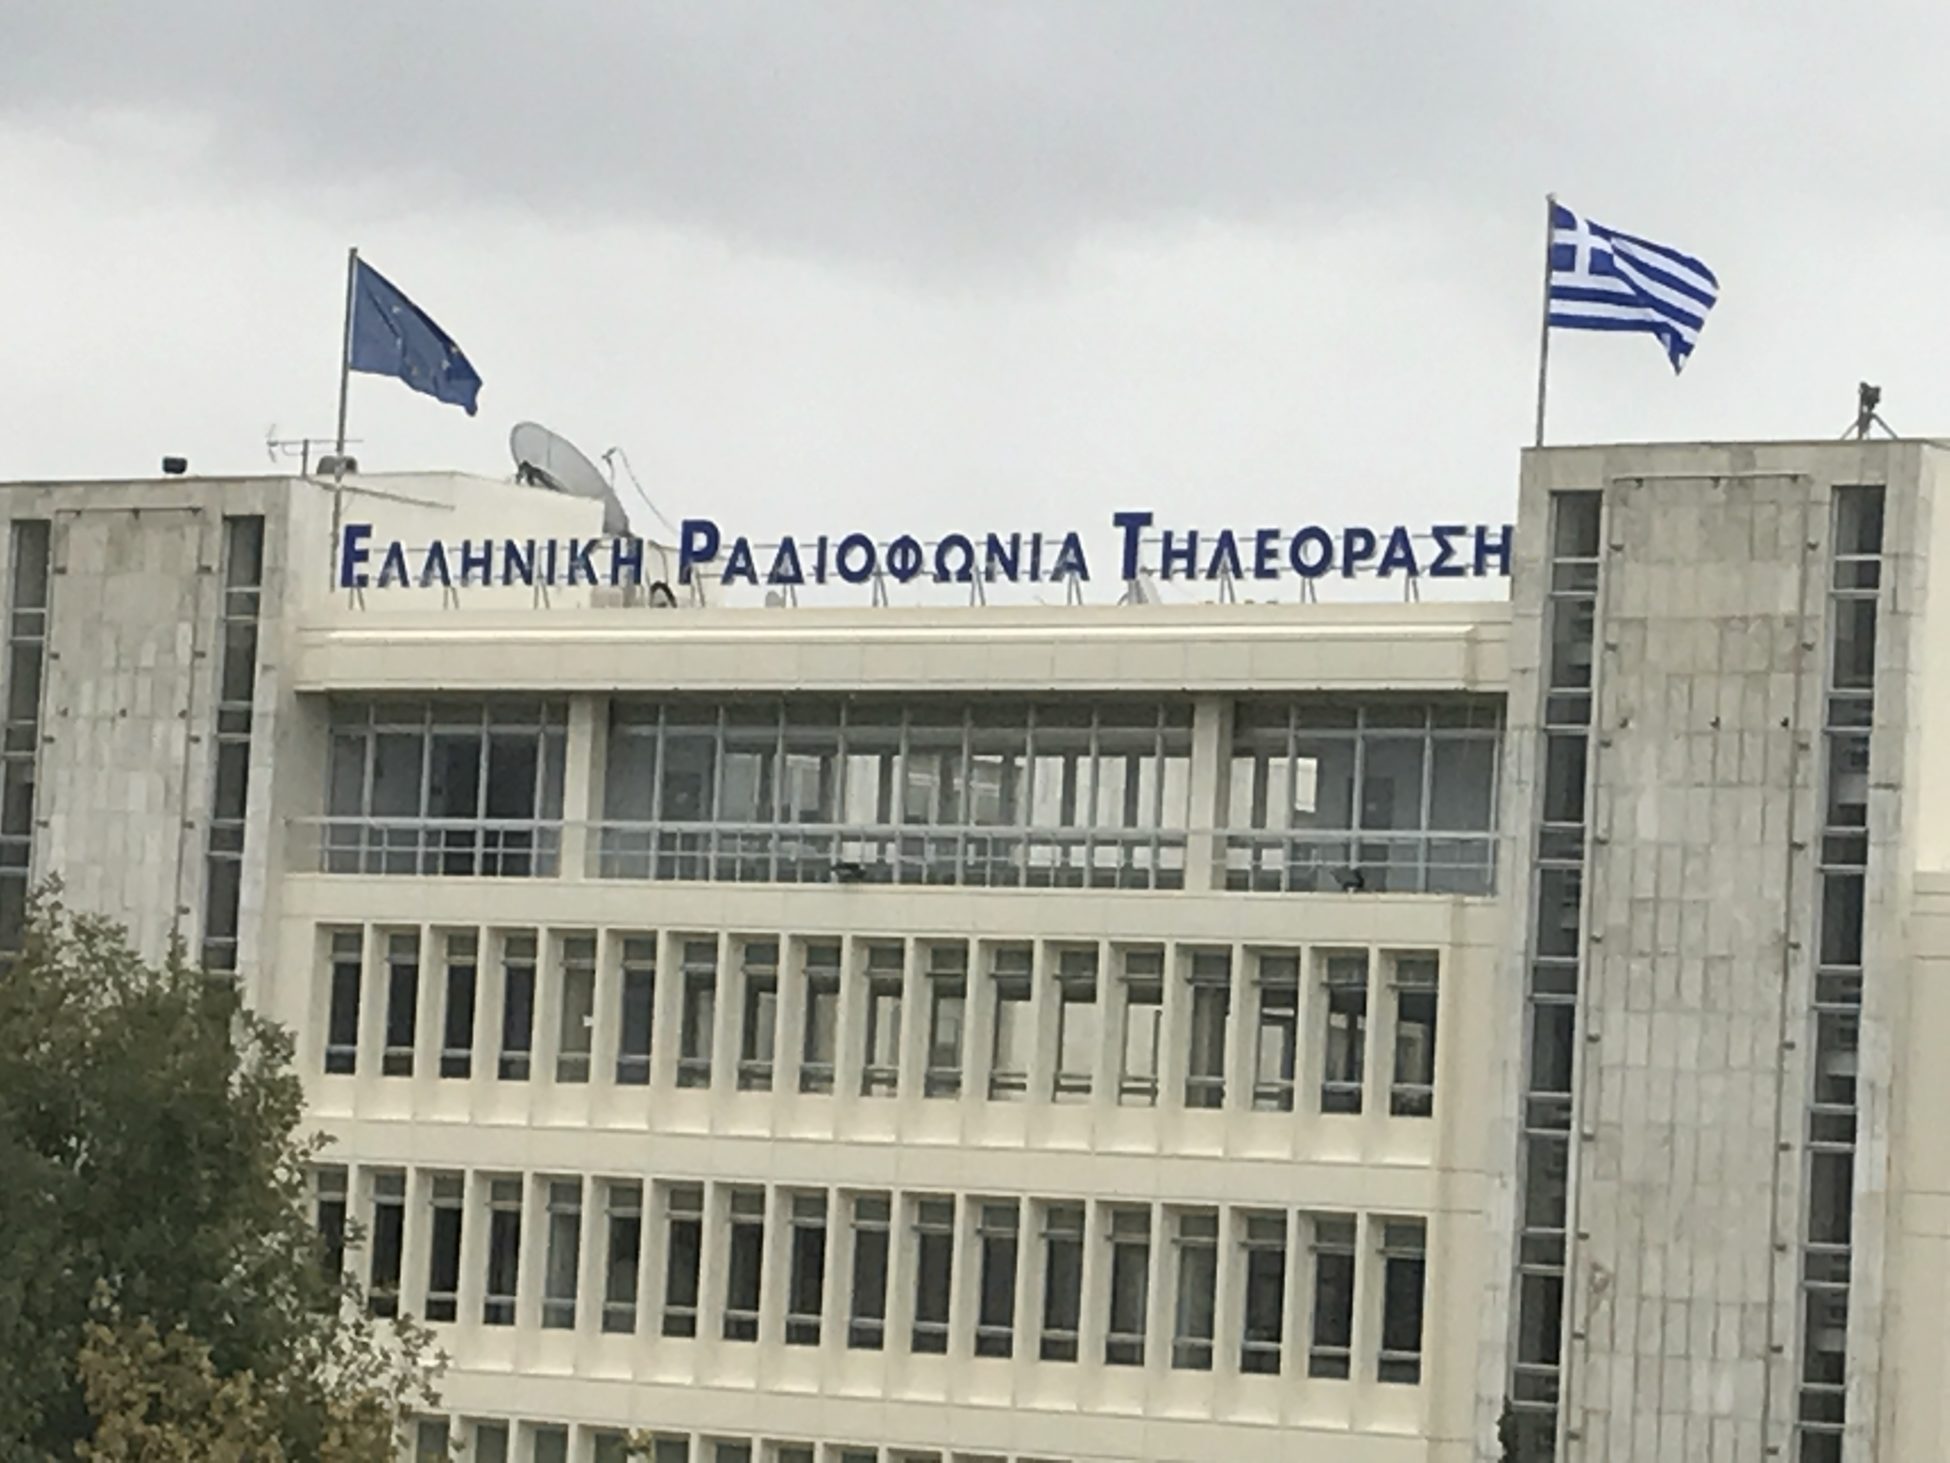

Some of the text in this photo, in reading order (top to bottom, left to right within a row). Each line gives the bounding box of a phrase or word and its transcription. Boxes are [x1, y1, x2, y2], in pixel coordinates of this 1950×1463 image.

[340, 511, 1513, 587] ΕΛΛΗΝΙΚΗ ΡΑΔΙΟΦΩΝΙΑ ΤΗΛΕΟΡΑΣΗ
